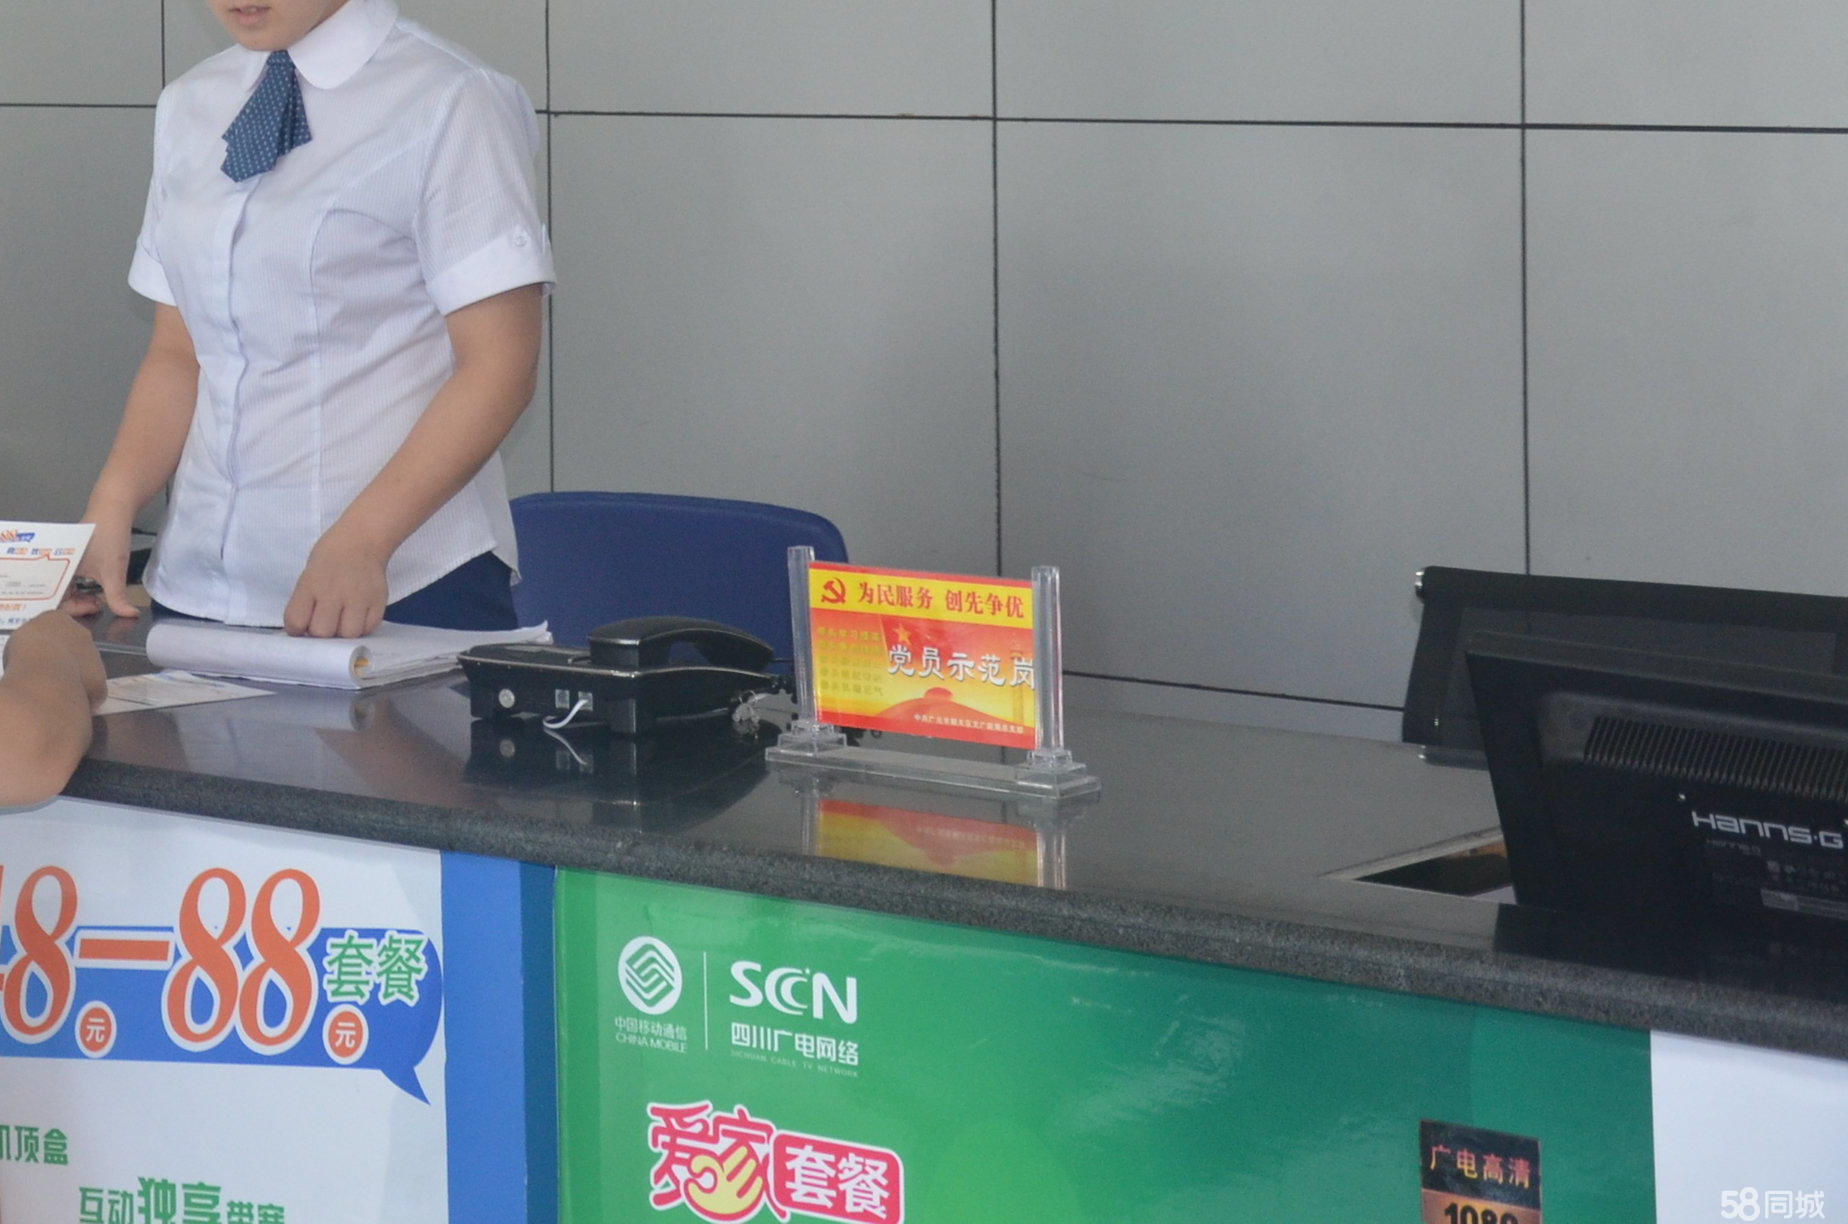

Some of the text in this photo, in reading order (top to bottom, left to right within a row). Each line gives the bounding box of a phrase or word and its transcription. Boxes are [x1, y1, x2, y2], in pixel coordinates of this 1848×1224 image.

[859, 581, 1024, 619] 为民服务 创先争优
[888, 644, 1036, 690] 党员示范岗
[324, 934, 429, 1004] 套餐
[614, 1016, 688, 1041] 中国移动通信
[615, 1033, 688, 1055] CHINA MOBILE
[731, 1021, 860, 1067] 四川广电网络
[1429, 1144, 1531, 1189] 广电高清
